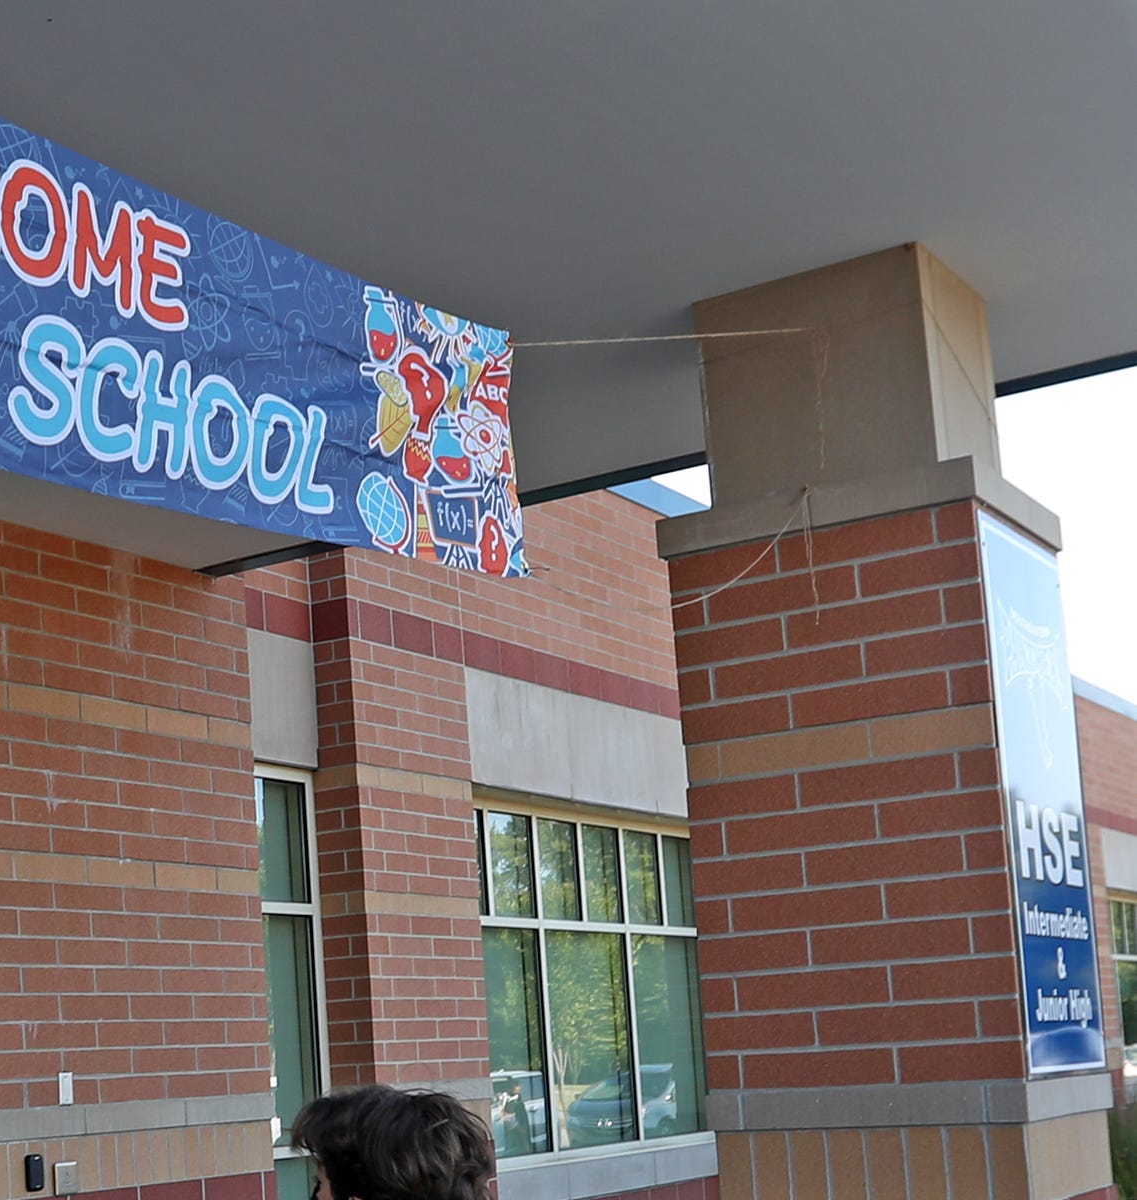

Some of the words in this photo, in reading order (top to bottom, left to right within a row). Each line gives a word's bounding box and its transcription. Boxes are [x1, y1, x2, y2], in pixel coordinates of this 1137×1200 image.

[475, 380, 508, 405] ABC
[8, 314, 334, 515] SCHOOL
[437, 501, 473, 535] f(x)=
[1016, 800, 1084, 887] HSE
[1023, 901, 1089, 940] Intermediate
[1057, 946, 1067, 980] &
[1036, 988, 1069, 1022] Junior
[1069, 989, 1093, 1029] High
